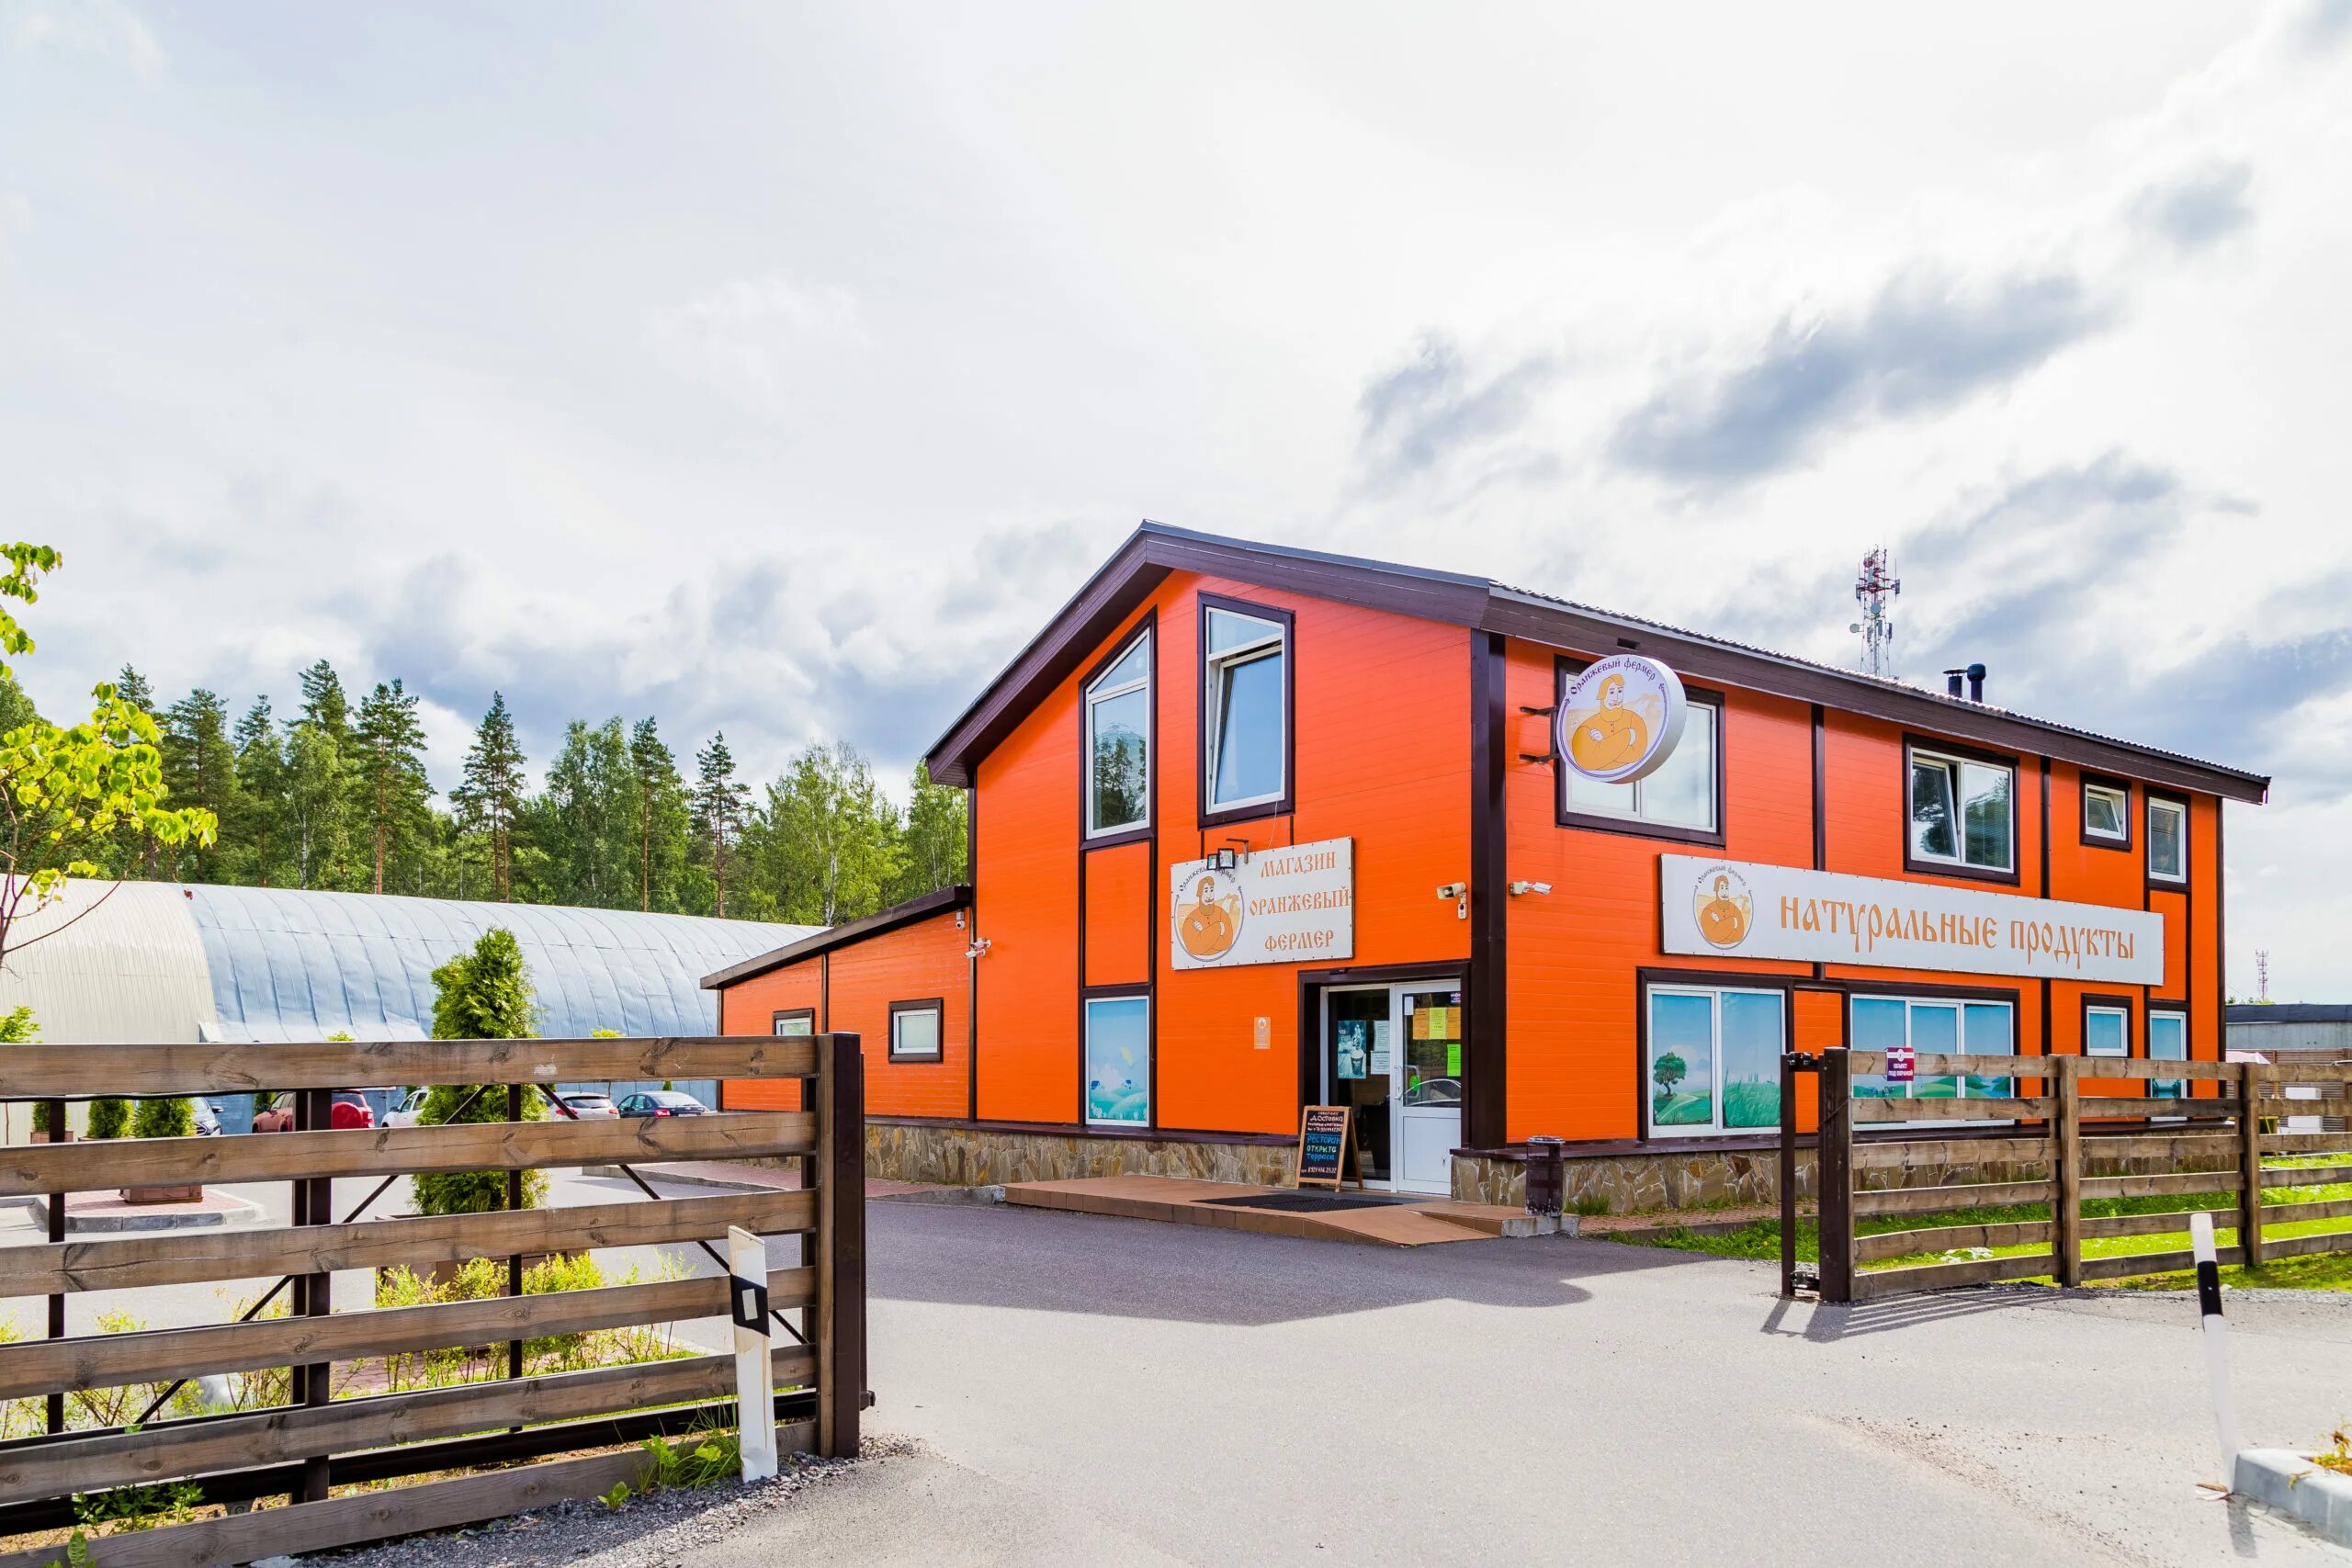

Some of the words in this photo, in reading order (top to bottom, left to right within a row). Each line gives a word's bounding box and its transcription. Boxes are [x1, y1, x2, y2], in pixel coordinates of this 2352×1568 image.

[1570, 658, 1621, 695] Оранжевый
[1623, 657, 1656, 682] фермер
[1261, 851, 1337, 878] МАГАЗИН
[1250, 886, 1350, 917] ОРАНЖЕВЫЙ
[1264, 930, 1334, 952] ФЕРМЕР
